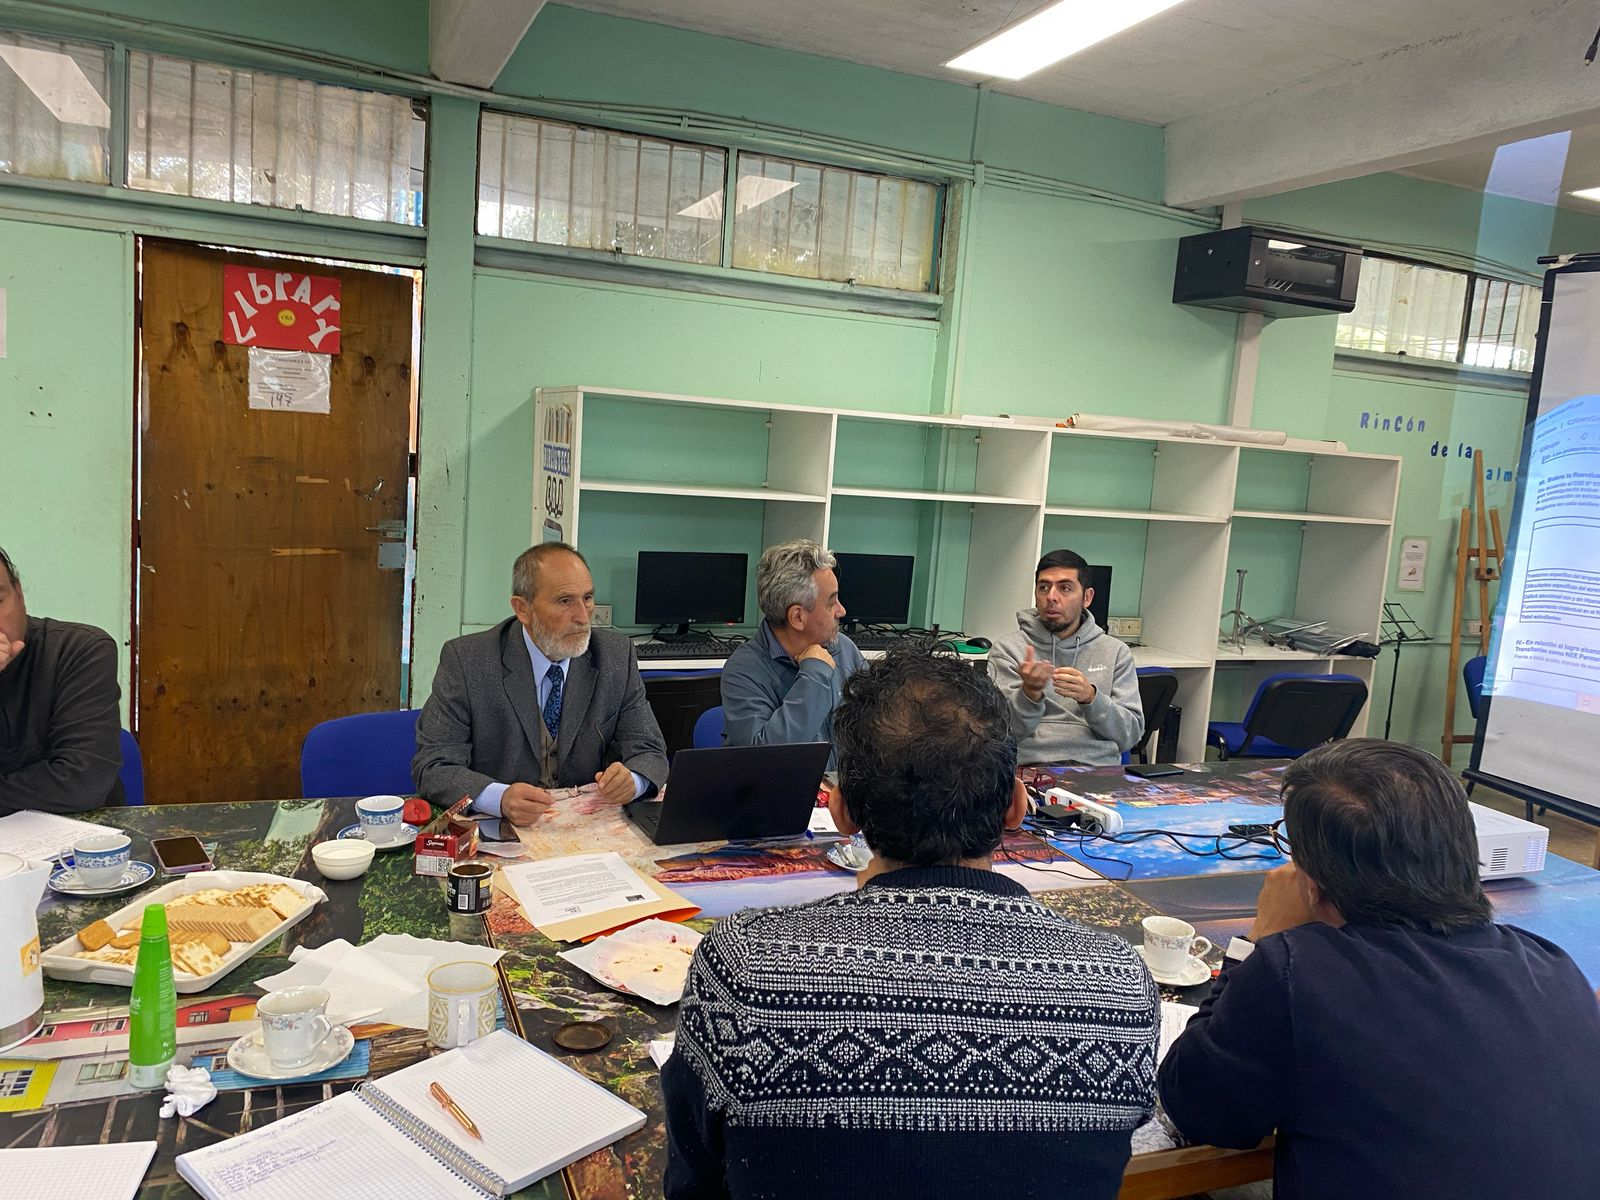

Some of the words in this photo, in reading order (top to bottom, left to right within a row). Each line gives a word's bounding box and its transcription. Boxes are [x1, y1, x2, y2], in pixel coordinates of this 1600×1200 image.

[1431, 440, 1448, 457] de
[1458, 442, 1473, 459] la
[1486, 467, 1519, 483] alm
